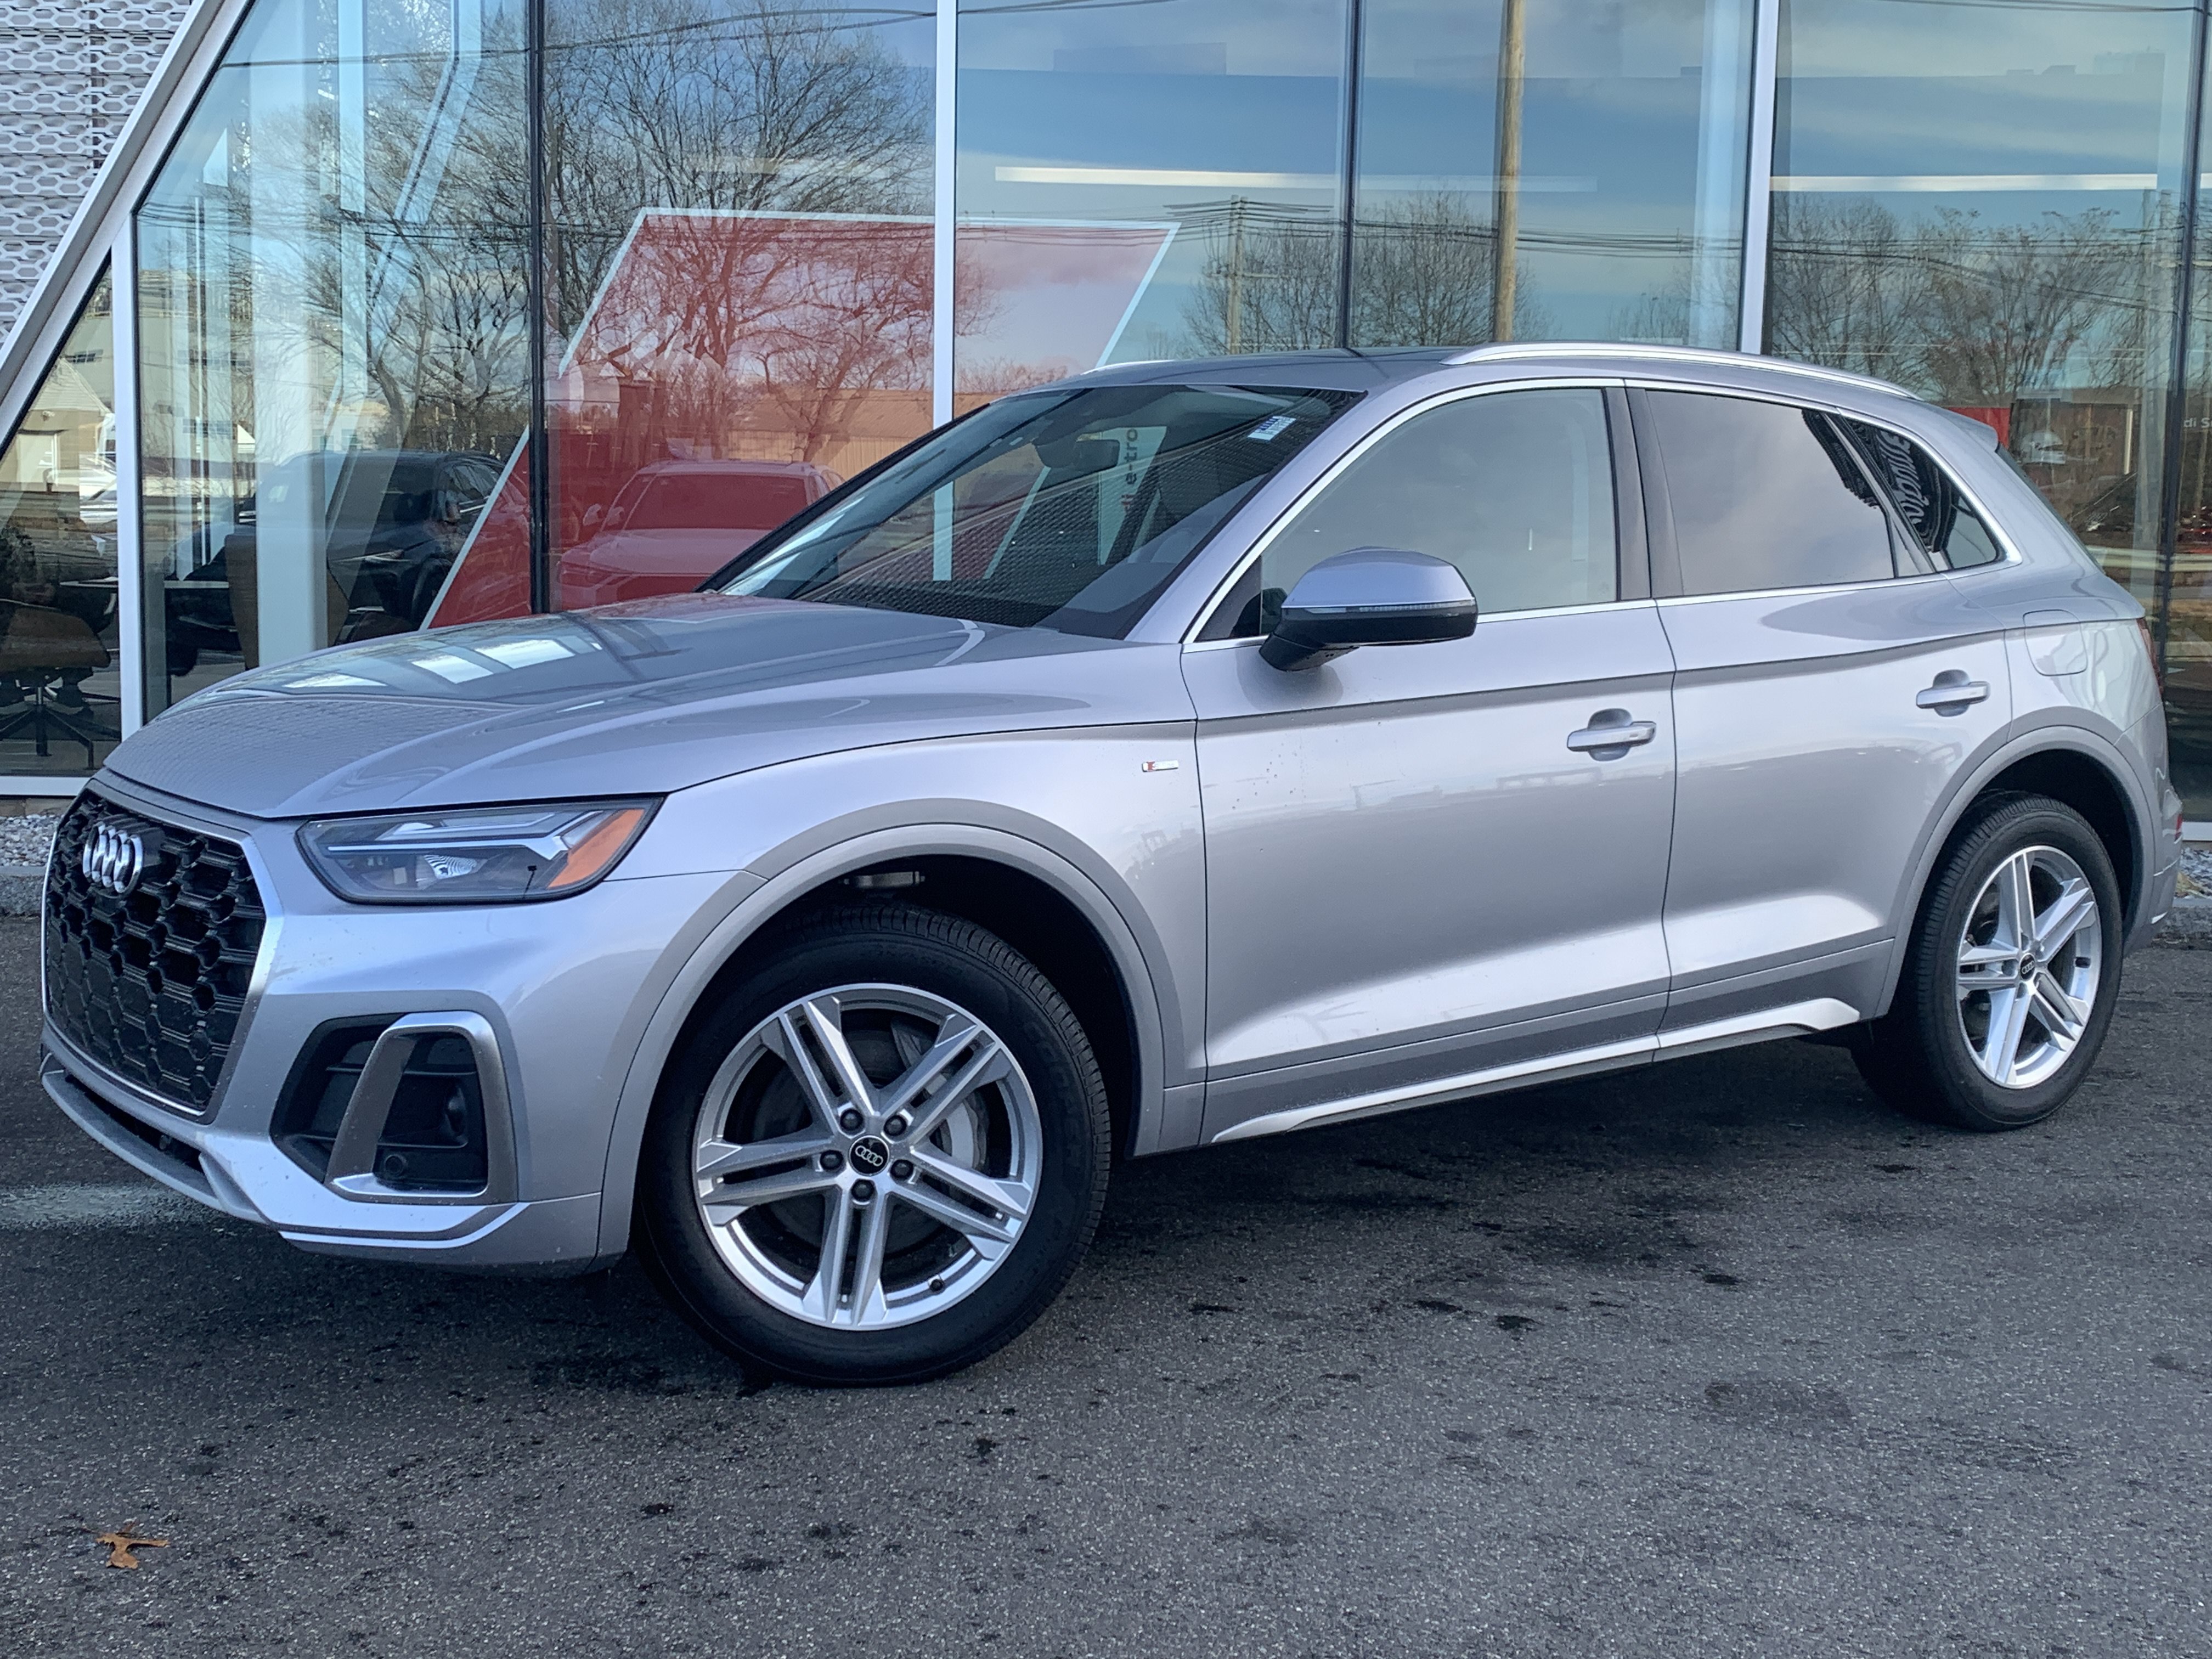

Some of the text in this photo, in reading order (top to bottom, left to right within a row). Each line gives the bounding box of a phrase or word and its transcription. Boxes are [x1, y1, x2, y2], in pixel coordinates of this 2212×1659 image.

[2184, 417, 2212, 428] di S
[1124, 428, 1138, 484] e-tro
